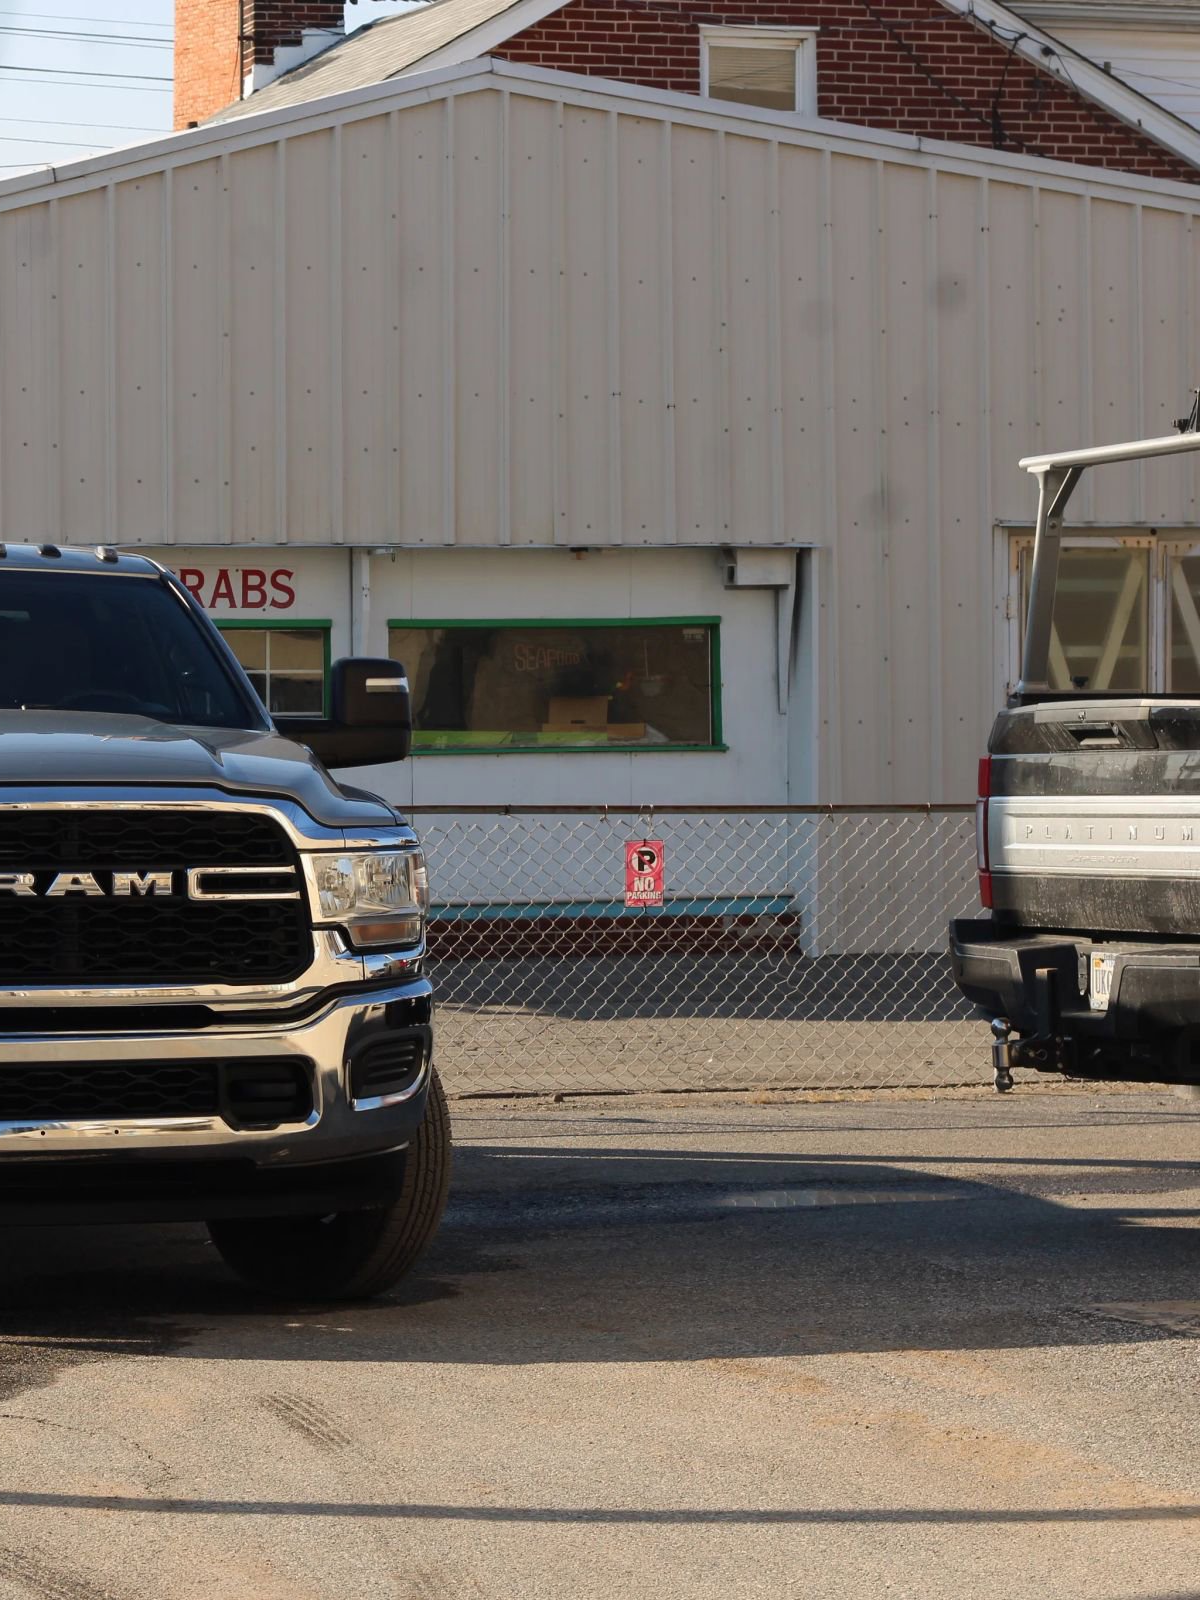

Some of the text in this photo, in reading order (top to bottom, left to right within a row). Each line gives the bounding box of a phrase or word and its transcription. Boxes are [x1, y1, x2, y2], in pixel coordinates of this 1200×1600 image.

[174, 568, 295, 609] RABS
[1025, 824, 1194, 841] PLATINUM
[633, 877, 655, 892] NO
[627, 891, 661, 900] PARKING
